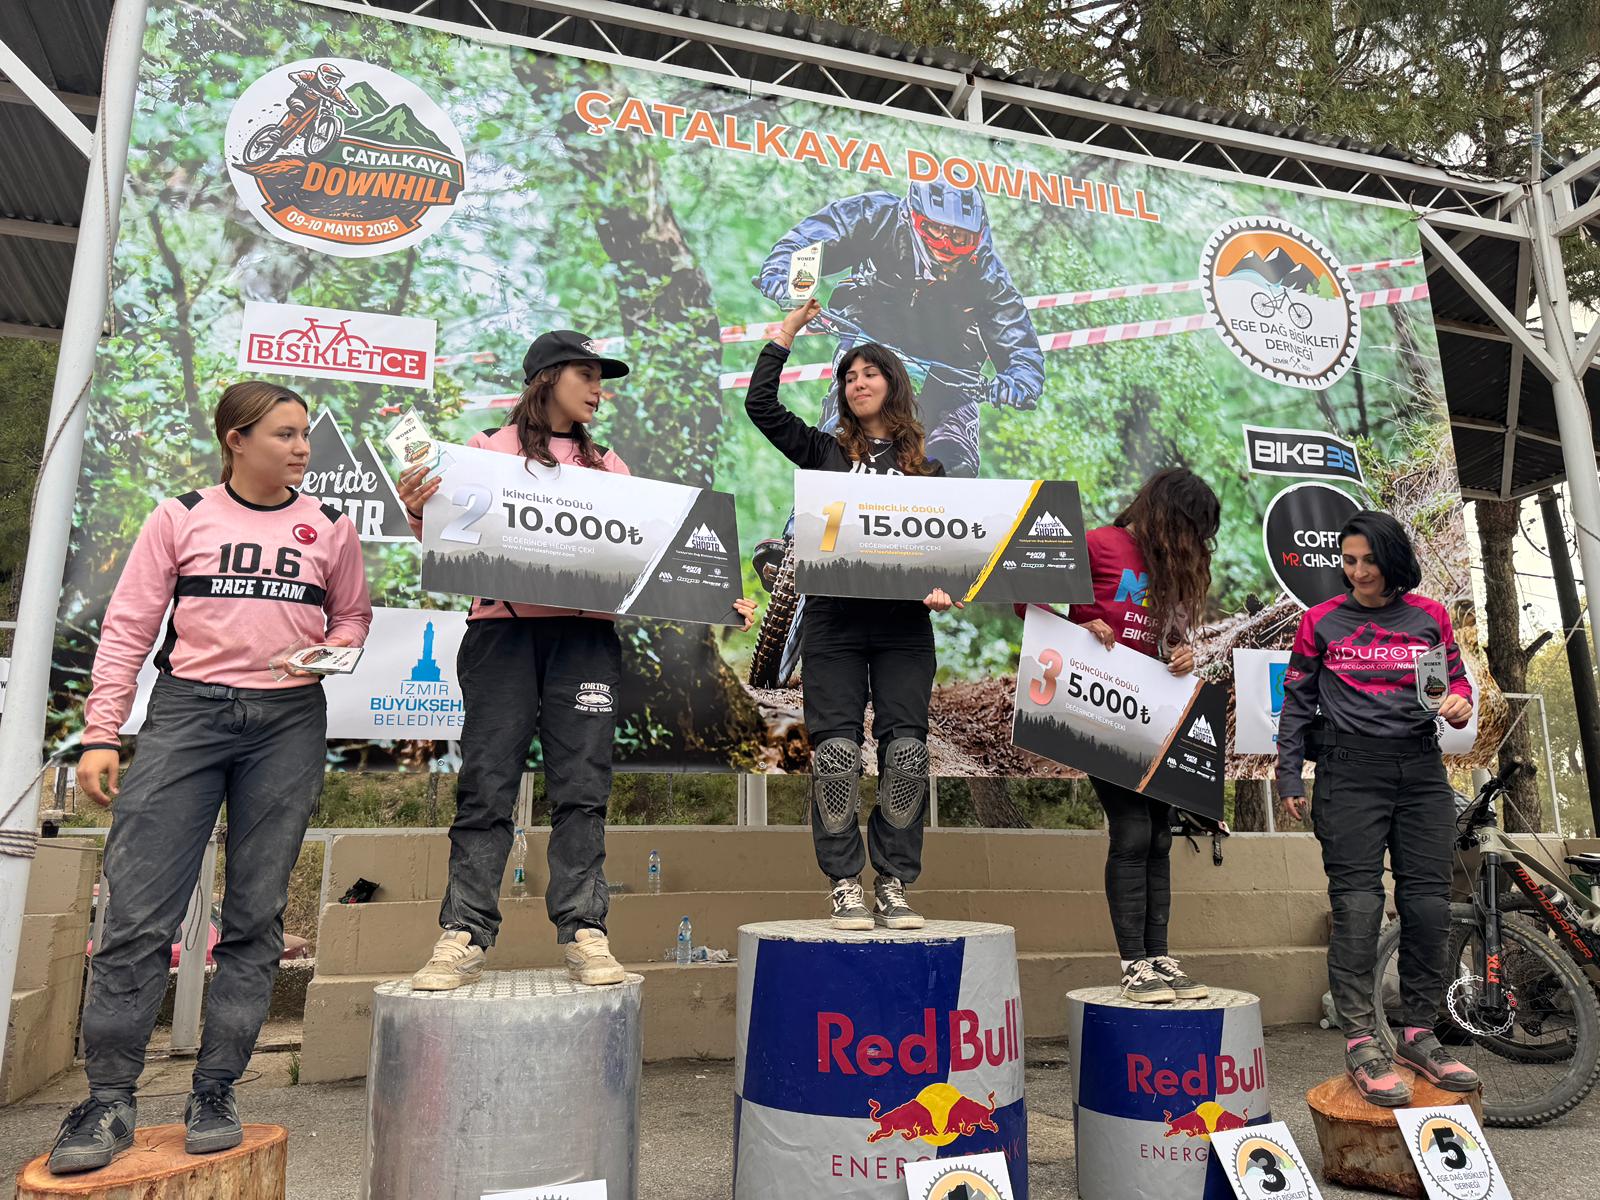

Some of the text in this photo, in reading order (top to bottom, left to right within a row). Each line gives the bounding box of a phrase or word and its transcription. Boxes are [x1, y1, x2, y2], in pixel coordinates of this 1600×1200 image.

[342, 146, 452, 178] ÇATALKAYA
[575, 91, 1161, 223] ÇATALKAYA DOWNHILL
[303, 161, 453, 203] DOWNHILL
[286, 210, 399, 237] 09-10 MAYIS 2026
[1231, 319, 1257, 332] EGE
[1260, 322, 1287, 337] DAĞ
[440, 484, 493, 545] 2
[502, 487, 593, 511] İKİNCİLİK ÖDÜLÜ
[858, 502, 945, 514] BİRİNCİLİK ÖDÜLÜ
[820, 501, 846, 553] 1
[218, 543, 302, 578] 10.6
[211, 578, 307, 600] RACE TEAM
[400, 682, 449, 695] İZMİR
[1029, 648, 1064, 706] 3
[1069, 657, 1140, 694] ÜÇÜNCÜLÜK ÖDÜLÜ
[370, 695, 463, 713] BÜYÜKŞEH
[374, 714, 465, 726] BELEDİYES
[817, 998, 1019, 1076] Red Bull
[1126, 1047, 1264, 1096] Red Bull
[1140, 1144, 1208, 1162] ENERG
[1432, 1127, 1467, 1169] 5
[1249, 1148, 1286, 1192] 3
